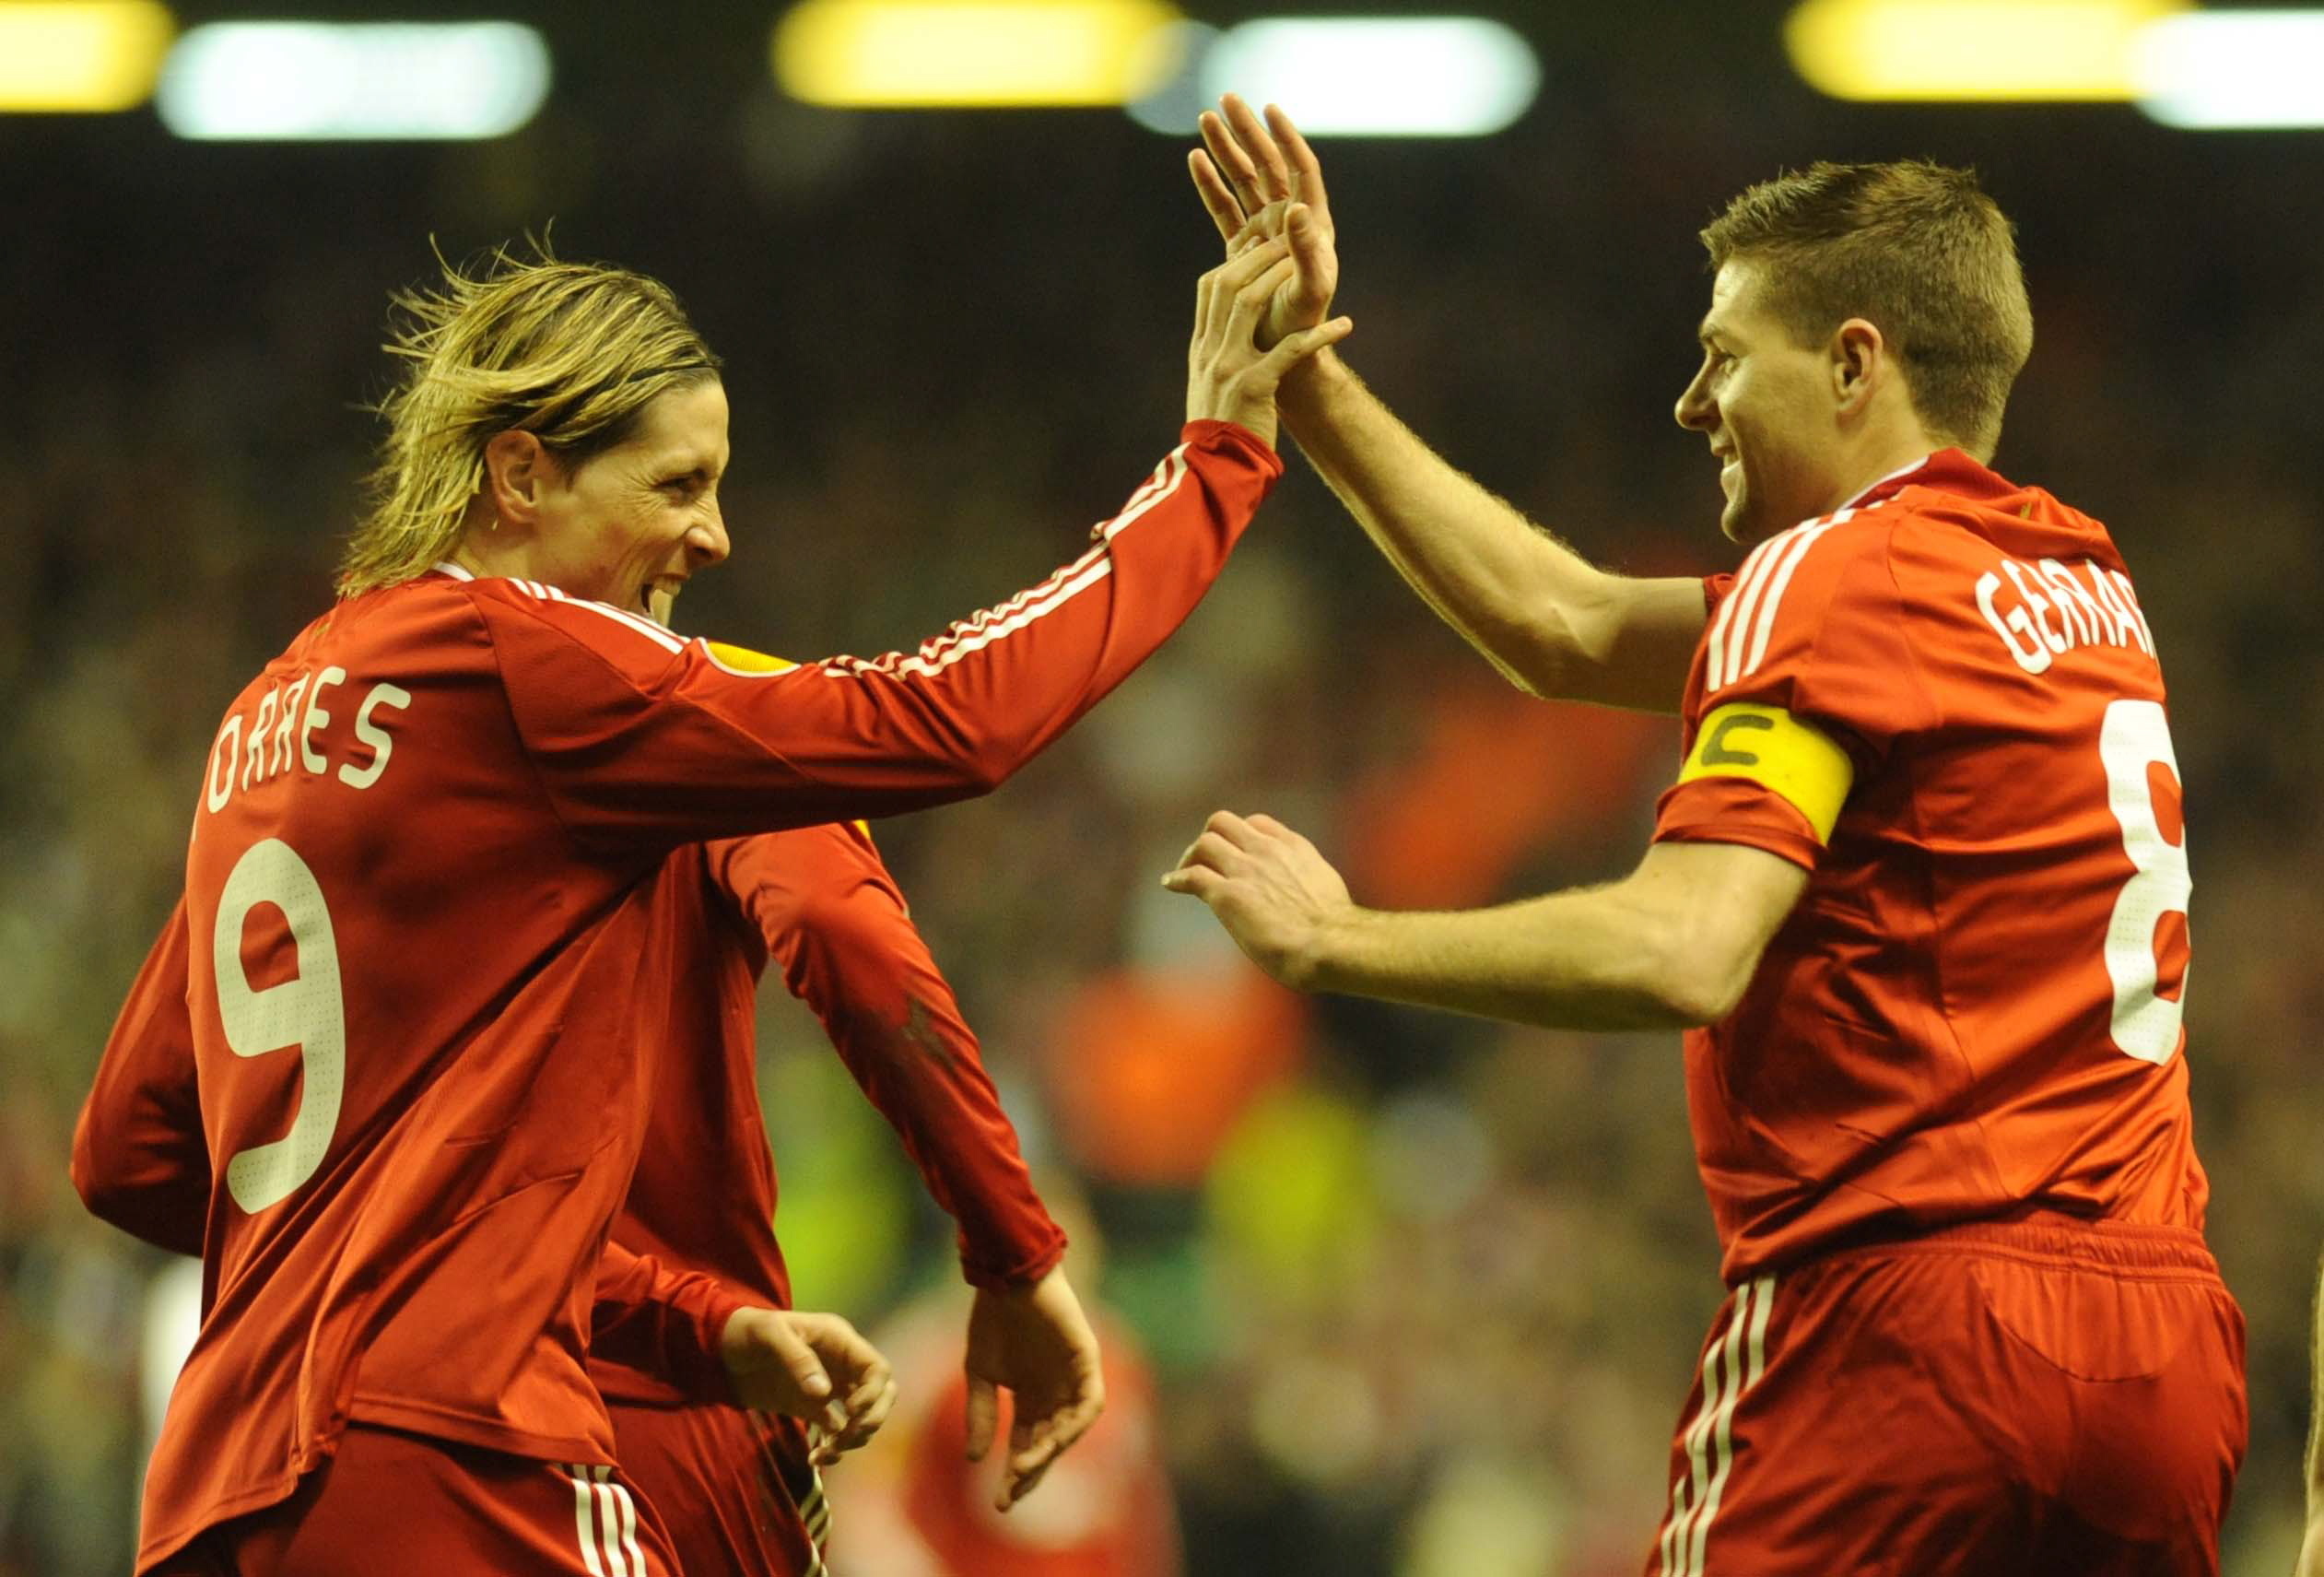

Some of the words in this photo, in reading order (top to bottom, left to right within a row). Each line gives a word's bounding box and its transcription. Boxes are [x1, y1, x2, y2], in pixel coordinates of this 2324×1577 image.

[1975, 558, 2161, 675] GERRAR
[191, 665, 412, 839] ORRES
[1701, 713, 1775, 767] C
[2099, 699, 2192, 1066] 8
[214, 838, 346, 1215] 9
